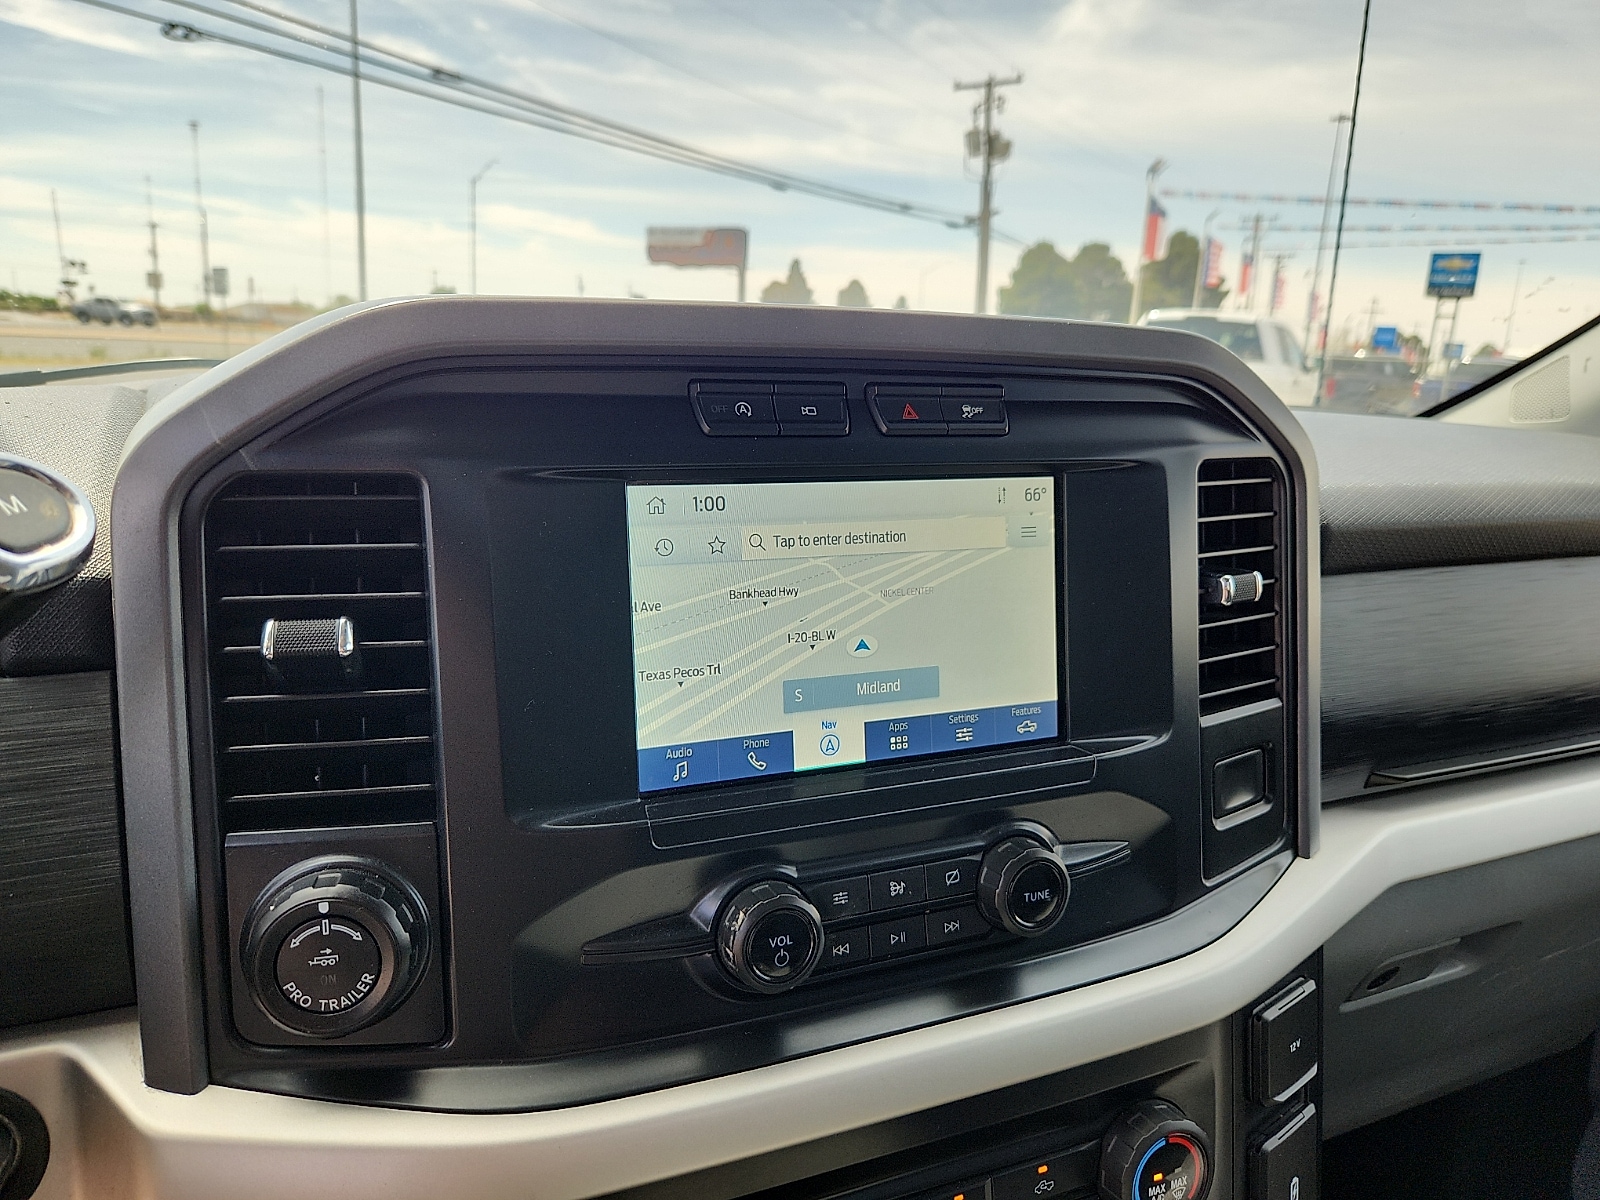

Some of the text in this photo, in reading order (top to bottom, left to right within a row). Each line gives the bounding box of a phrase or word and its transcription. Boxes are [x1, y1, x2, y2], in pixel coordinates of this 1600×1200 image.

[693, 495, 726, 512] 1:00
[773, 531, 907, 550] Tap to enter destination
[729, 586, 800, 600] Bankhead Hwy
[880, 586, 934, 598] NICKEL CENTER
[640, 601, 662, 613] Ave
[826, 629, 837, 641] W
[638, 663, 722, 682] Texas Pecos Trl
[856, 679, 901, 696] Midland
[794, 688, 803, 702] S
[1011, 705, 1042, 717] Features
[821, 720, 837, 730] Nav
[949, 713, 979, 726] Settings
[888, 721, 909, 733] Apps
[743, 737, 770, 749] Phone
[665, 747, 693, 760] Audio
[1023, 888, 1050, 903] TUNE
[769, 934, 793, 948] VOL
[282, 972, 376, 1011] PRO TRAILER
[1149, 1183, 1166, 1197] MAX
[1171, 1176, 1187, 1190] MAX
